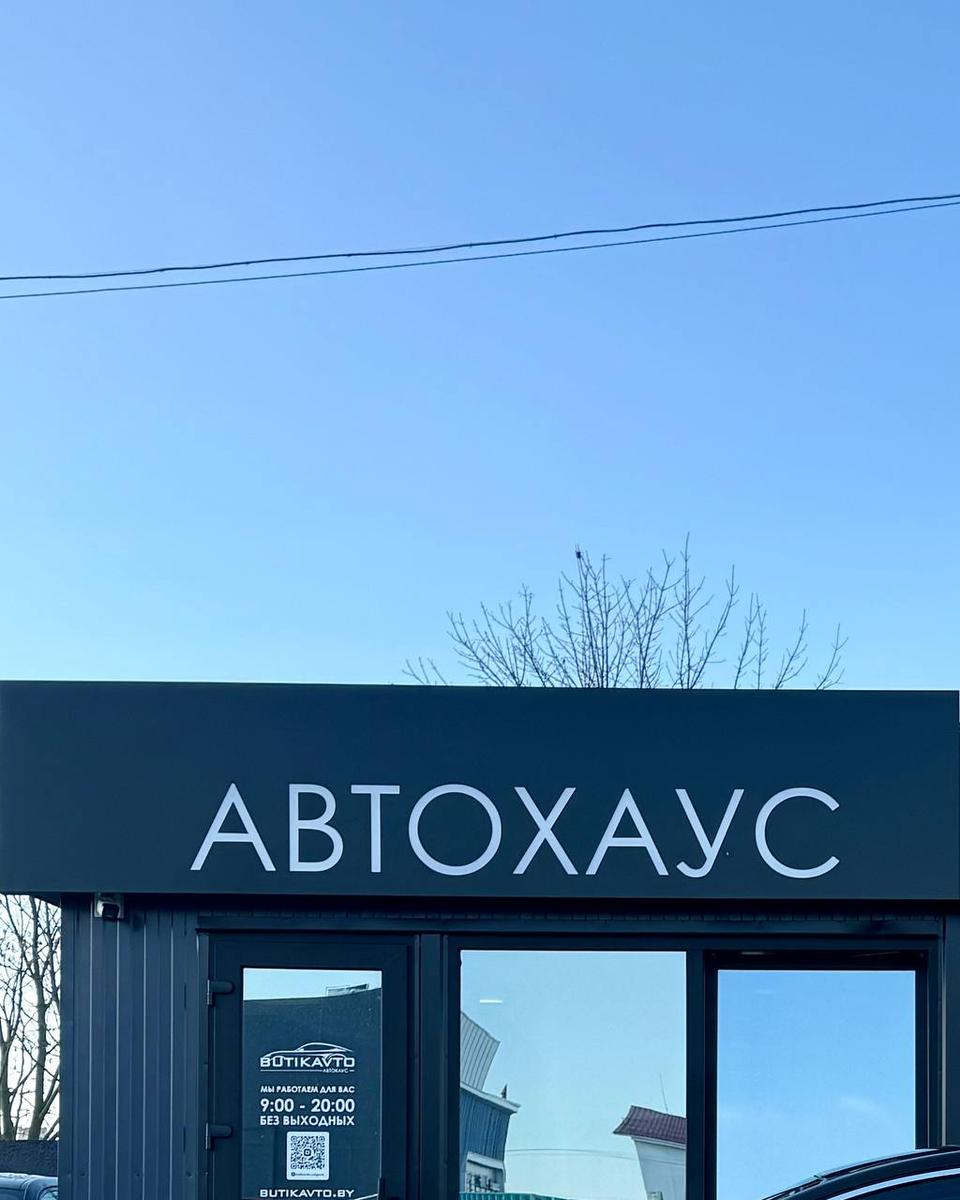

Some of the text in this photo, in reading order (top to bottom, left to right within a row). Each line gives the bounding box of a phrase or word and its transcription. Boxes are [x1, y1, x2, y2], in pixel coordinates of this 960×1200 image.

[191, 783, 840, 879] АВТОХАУС
[260, 1057, 355, 1068] BUTIKAVTO
[260, 1085, 356, 1094] МЫ РАБОТАЕМ ДЛЯ ВАС
[260, 1098, 295, 1113] 9:00
[310, 1098, 356, 1113] 20:00
[260, 1115, 355, 1127] БЕЗ ВЫХОДНЫХ
[260, 1189, 355, 1198] BUTIKAVTO.BY
